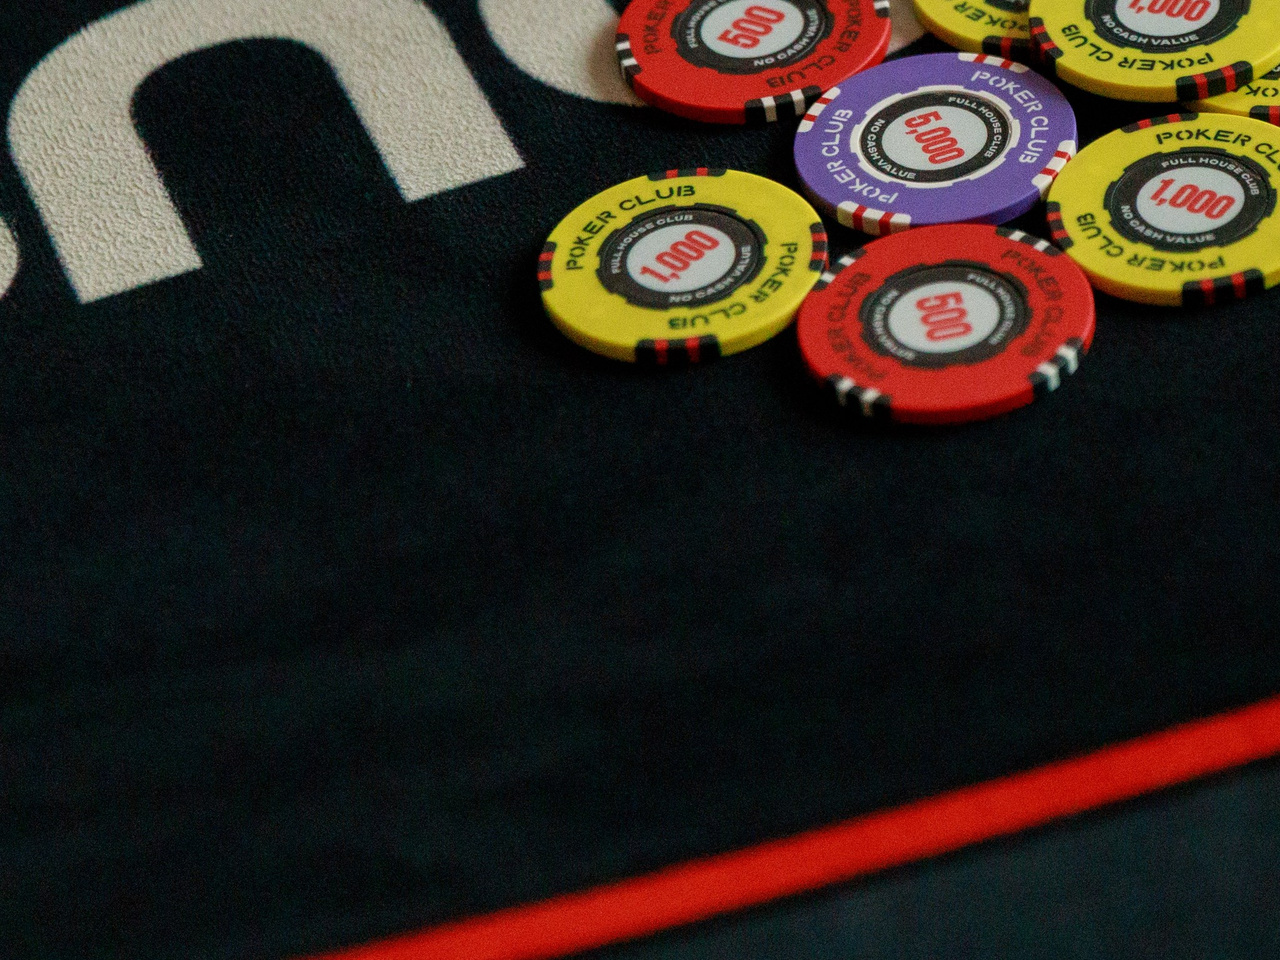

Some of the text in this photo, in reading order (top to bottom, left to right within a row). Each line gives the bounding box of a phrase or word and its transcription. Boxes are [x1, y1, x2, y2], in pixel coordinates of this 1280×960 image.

[642, 2, 669, 55] POKER
[717, 5, 785, 49] 500
[1061, 23, 1214, 72] POKER CLUB
[1101, 14, 1199, 46] NO CASH VALUE
[767, 54, 835, 89] CLUB
[904, 110, 965, 164] 5,000
[948, 96, 1002, 158] FULL HOUSE CLUB
[970, 70, 1049, 165] POKER CLUB
[1155, 128, 1252, 147] POKER
[821, 109, 899, 204] POKER CLUB
[867, 118, 917, 180] NO CASH VALUE
[1150, 178, 1236, 220] 1,000
[1161, 157, 1260, 196] FULL HOUSE CLUB
[566, 185, 696, 270] POKER CLUB
[611, 215, 693, 274] FULL HOUSE CLUB
[1077, 212, 1226, 273] POKER CLUB
[1121, 205, 1215, 244] NO CASH VALUE
[640, 230, 720, 283] 1,000
[669, 245, 752, 303] NO CASH VALUE
[667, 242, 798, 330] POKER CLUB
[916, 291, 973, 341] 500
